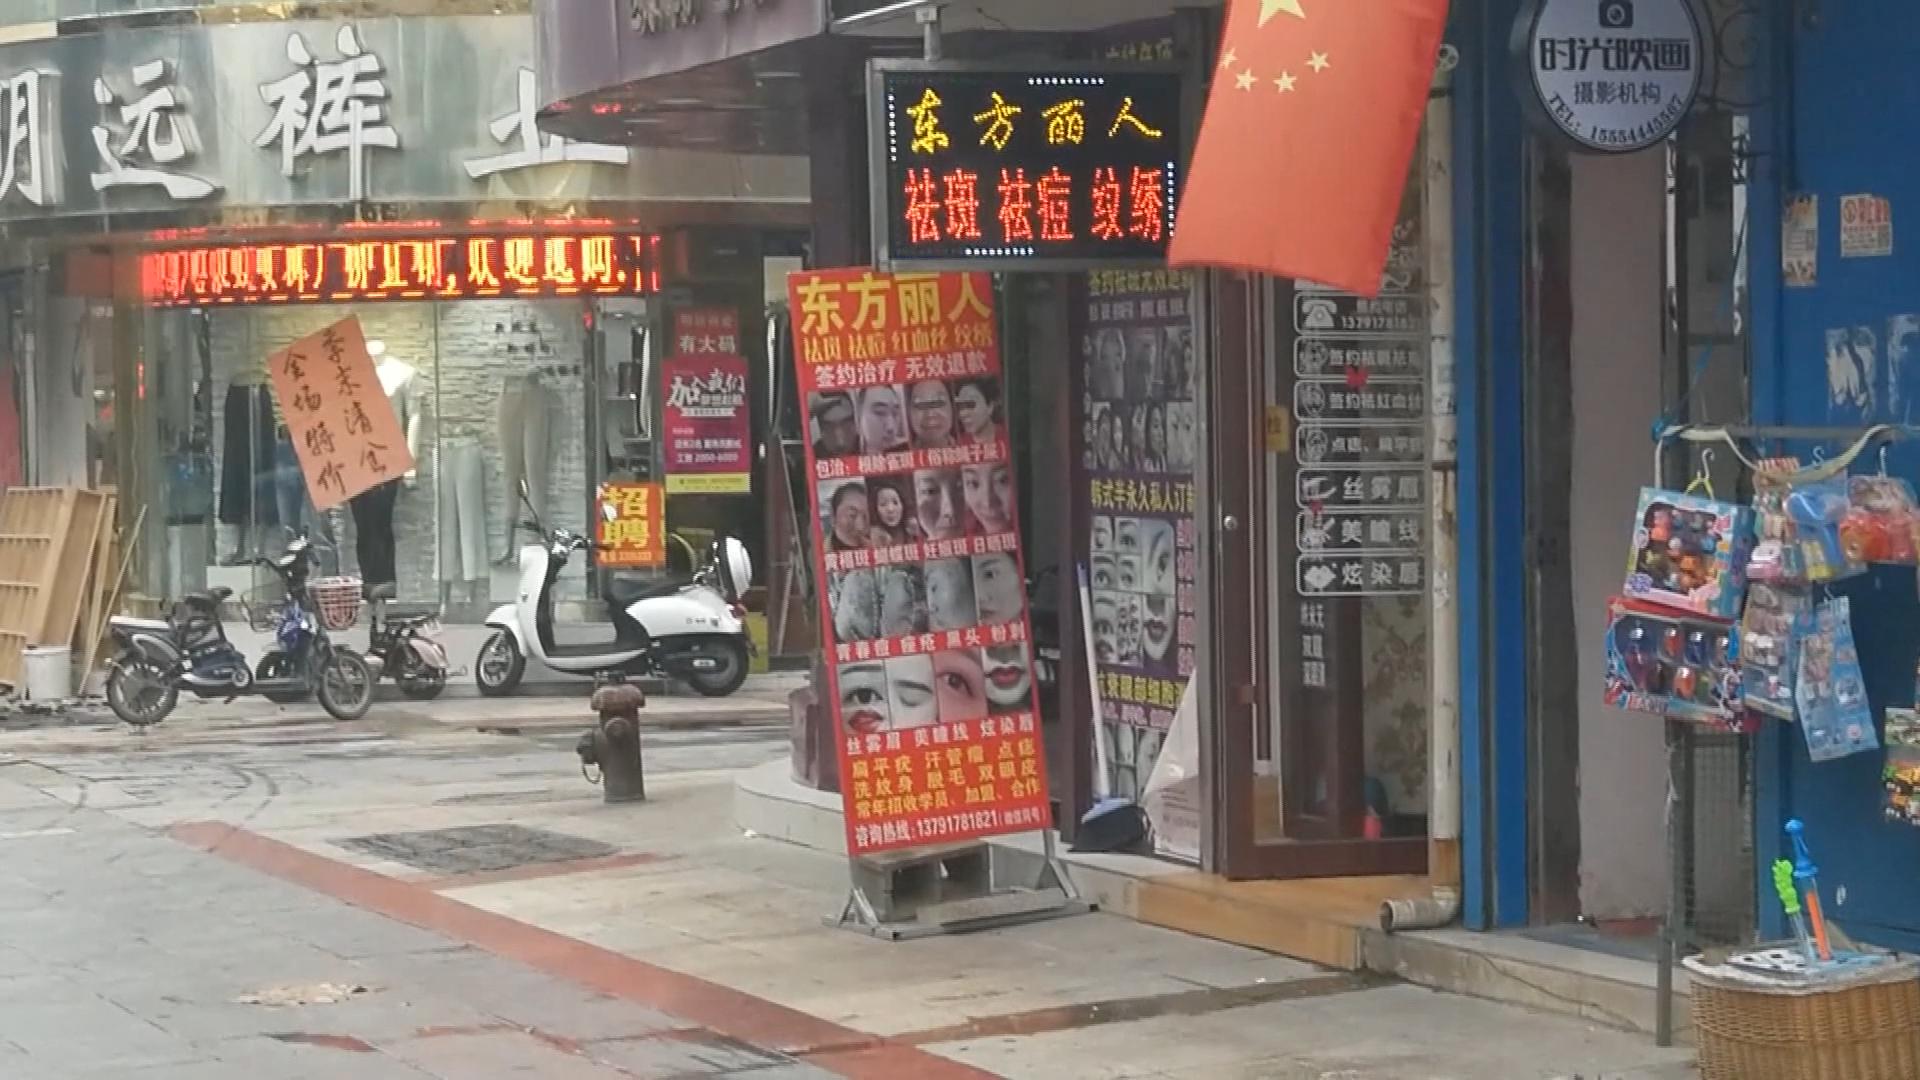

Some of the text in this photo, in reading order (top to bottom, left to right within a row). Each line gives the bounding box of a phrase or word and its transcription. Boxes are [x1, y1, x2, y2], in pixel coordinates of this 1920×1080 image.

[1539, 37, 1691, 71] 时光映画
[1574, 81, 1662, 105] 摄影机构
[906, 88, 1162, 154] 东方丽人
[904, 167, 981, 243] 祛斑
[997, 166, 1074, 243] 祛痘
[797, 272, 991, 336] 东方丽人
[680, 334, 736, 354] 有大码
[892, 325, 947, 353] 红血丝
[815, 350, 988, 388] 签约治疗 无效退款
[321, 328, 389, 474] 季末清仓
[283, 352, 346, 496] 全场特价
[946, 627, 981, 648] 黑头
[927, 767, 966, 789] 脱毛
[978, 758, 1038, 782] 双眼皮
